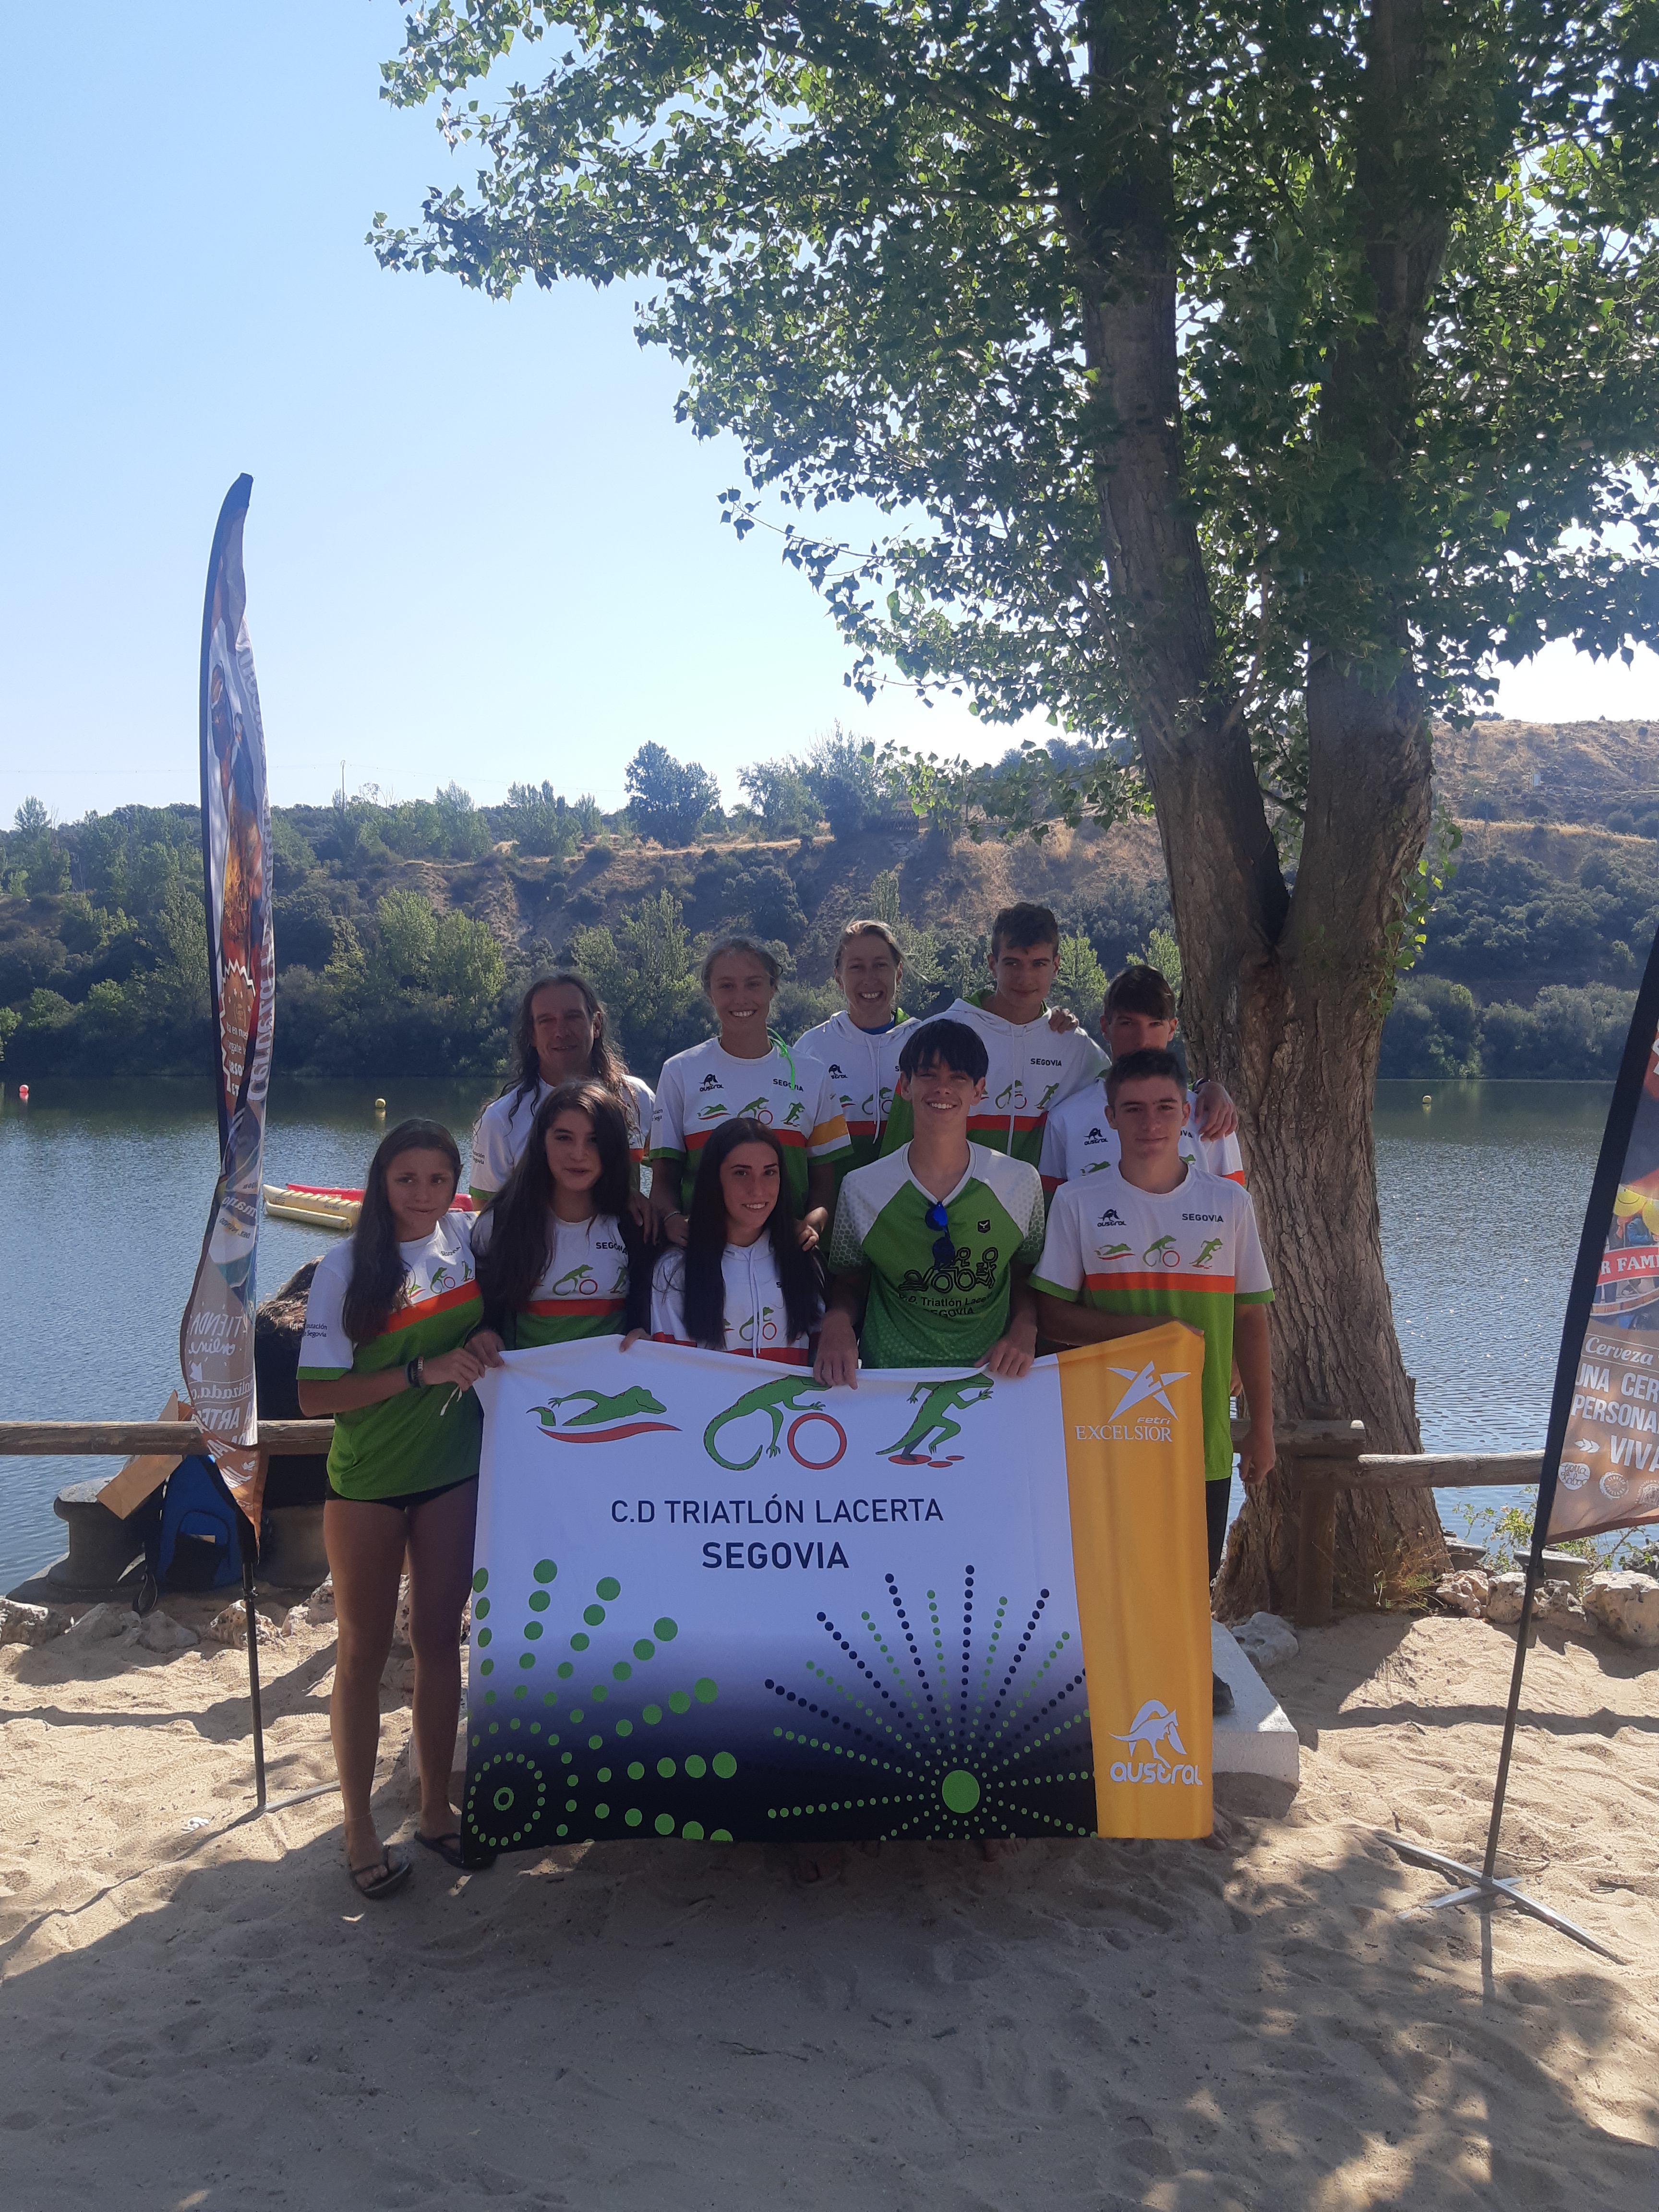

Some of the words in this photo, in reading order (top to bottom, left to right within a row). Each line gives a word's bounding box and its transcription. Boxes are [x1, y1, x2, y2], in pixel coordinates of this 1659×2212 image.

[1030, 1058, 1062, 1067] SEGOVIA
[1182, 1214, 1224, 1223] SEGOVIA
[921, 1296, 962, 1307] Triatlón
[307, 1330, 327, 1338] Segovia
[1585, 1337, 1654, 1365] Cerveza
[1571, 1394, 1659, 1434] PERSONA
[1075, 1425, 1173, 1443] EXCELSIOR
[612, 1500, 655, 1523] C.D
[664, 1493, 804, 1524] TRIATLÓN
[816, 1498, 944, 1523] LACERTA
[702, 1541, 850, 1569] SEGOVIA
[1110, 1761, 1203, 1785] austral
